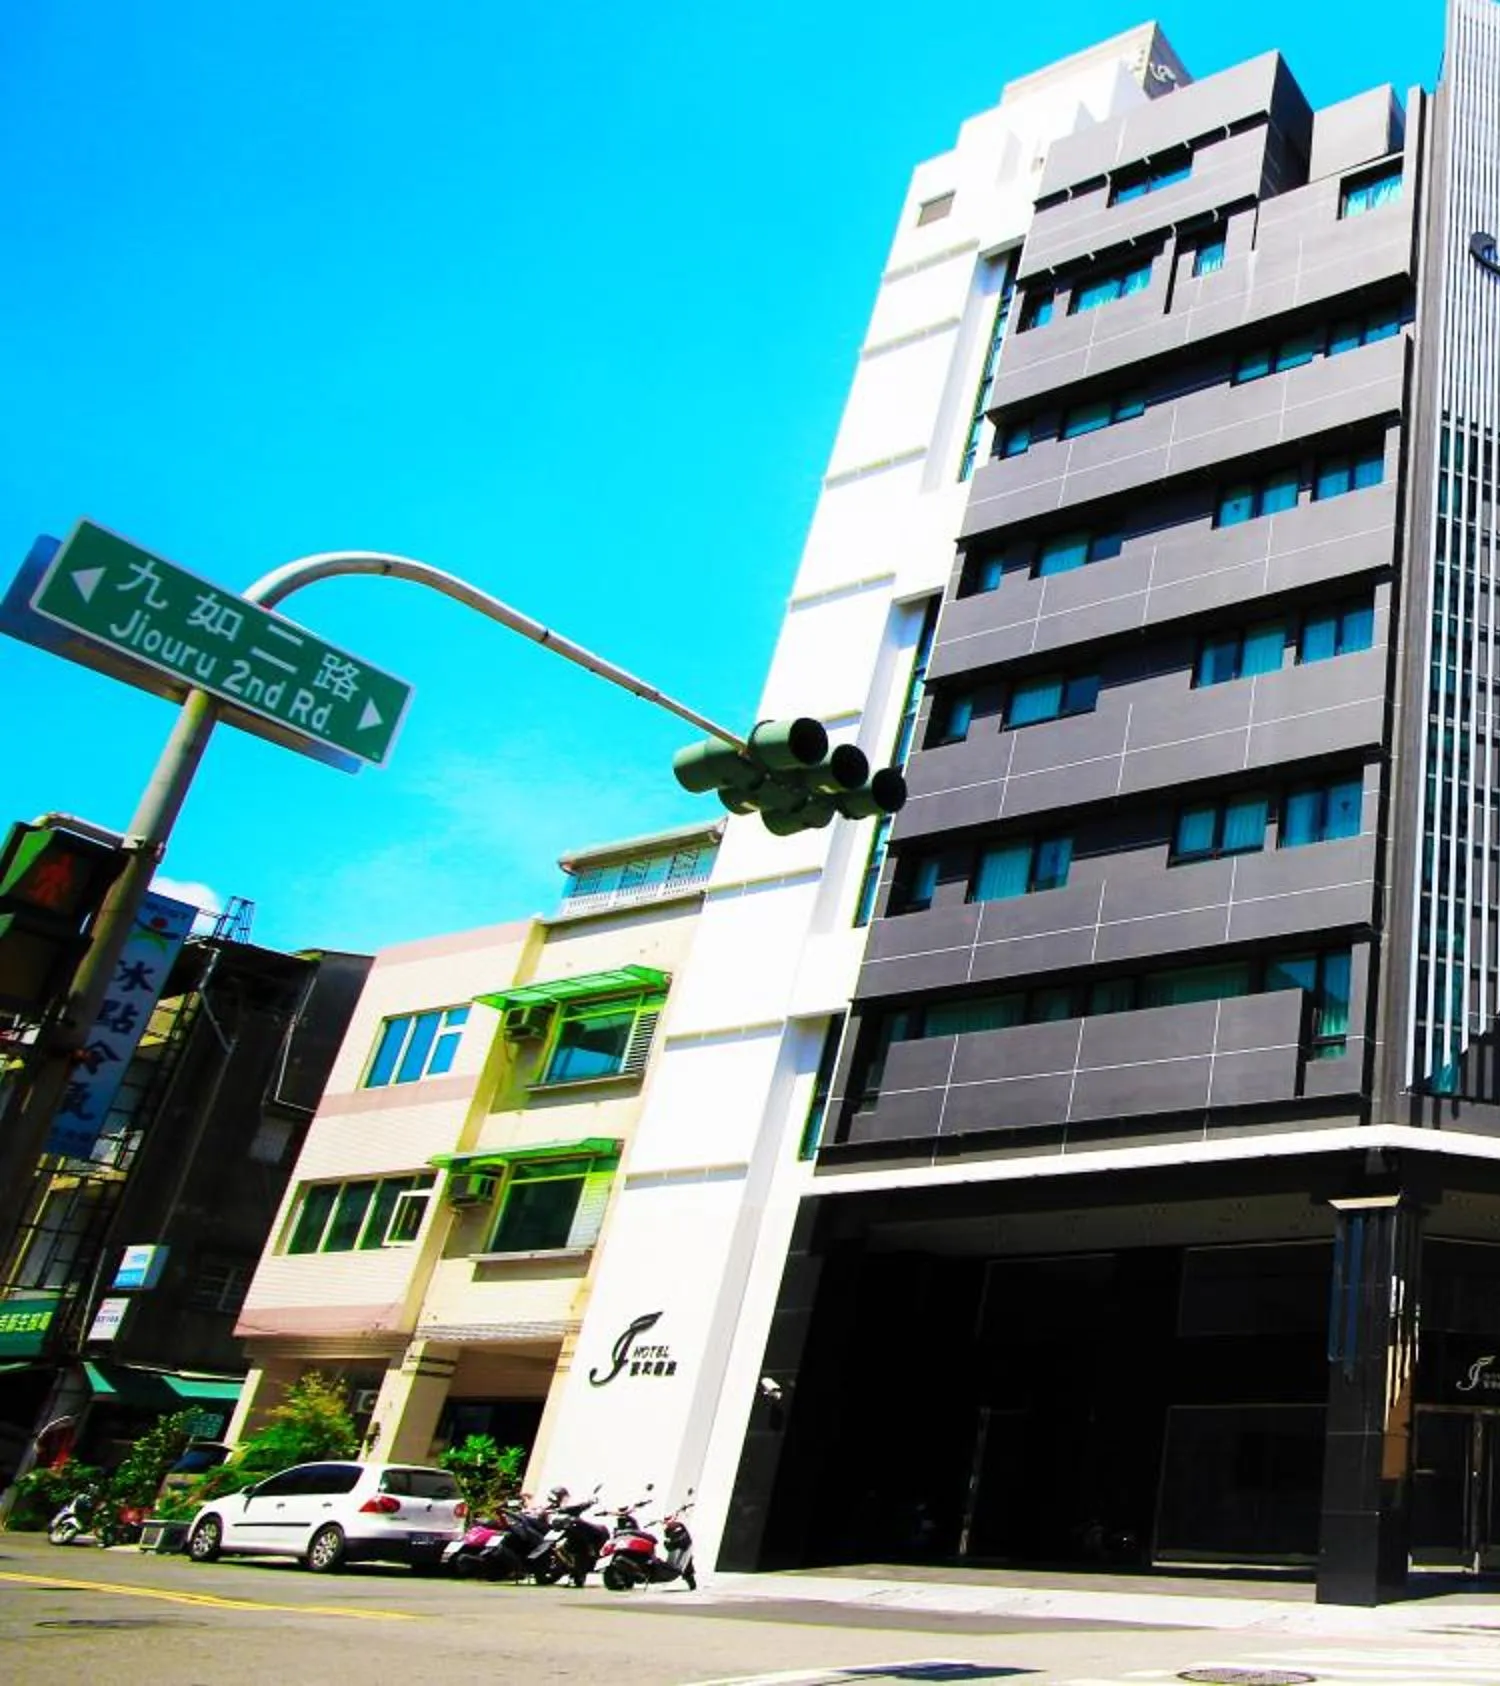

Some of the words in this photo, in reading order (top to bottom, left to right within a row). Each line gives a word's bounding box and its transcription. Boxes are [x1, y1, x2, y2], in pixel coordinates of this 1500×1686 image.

[109, 608, 219, 678] Jiouru
[221, 658, 287, 710] 2nd
[287, 687, 333, 736] Rd.
[115, 559, 361, 703] 九如二路
[633, 1345, 669, 1359] HOTEL
